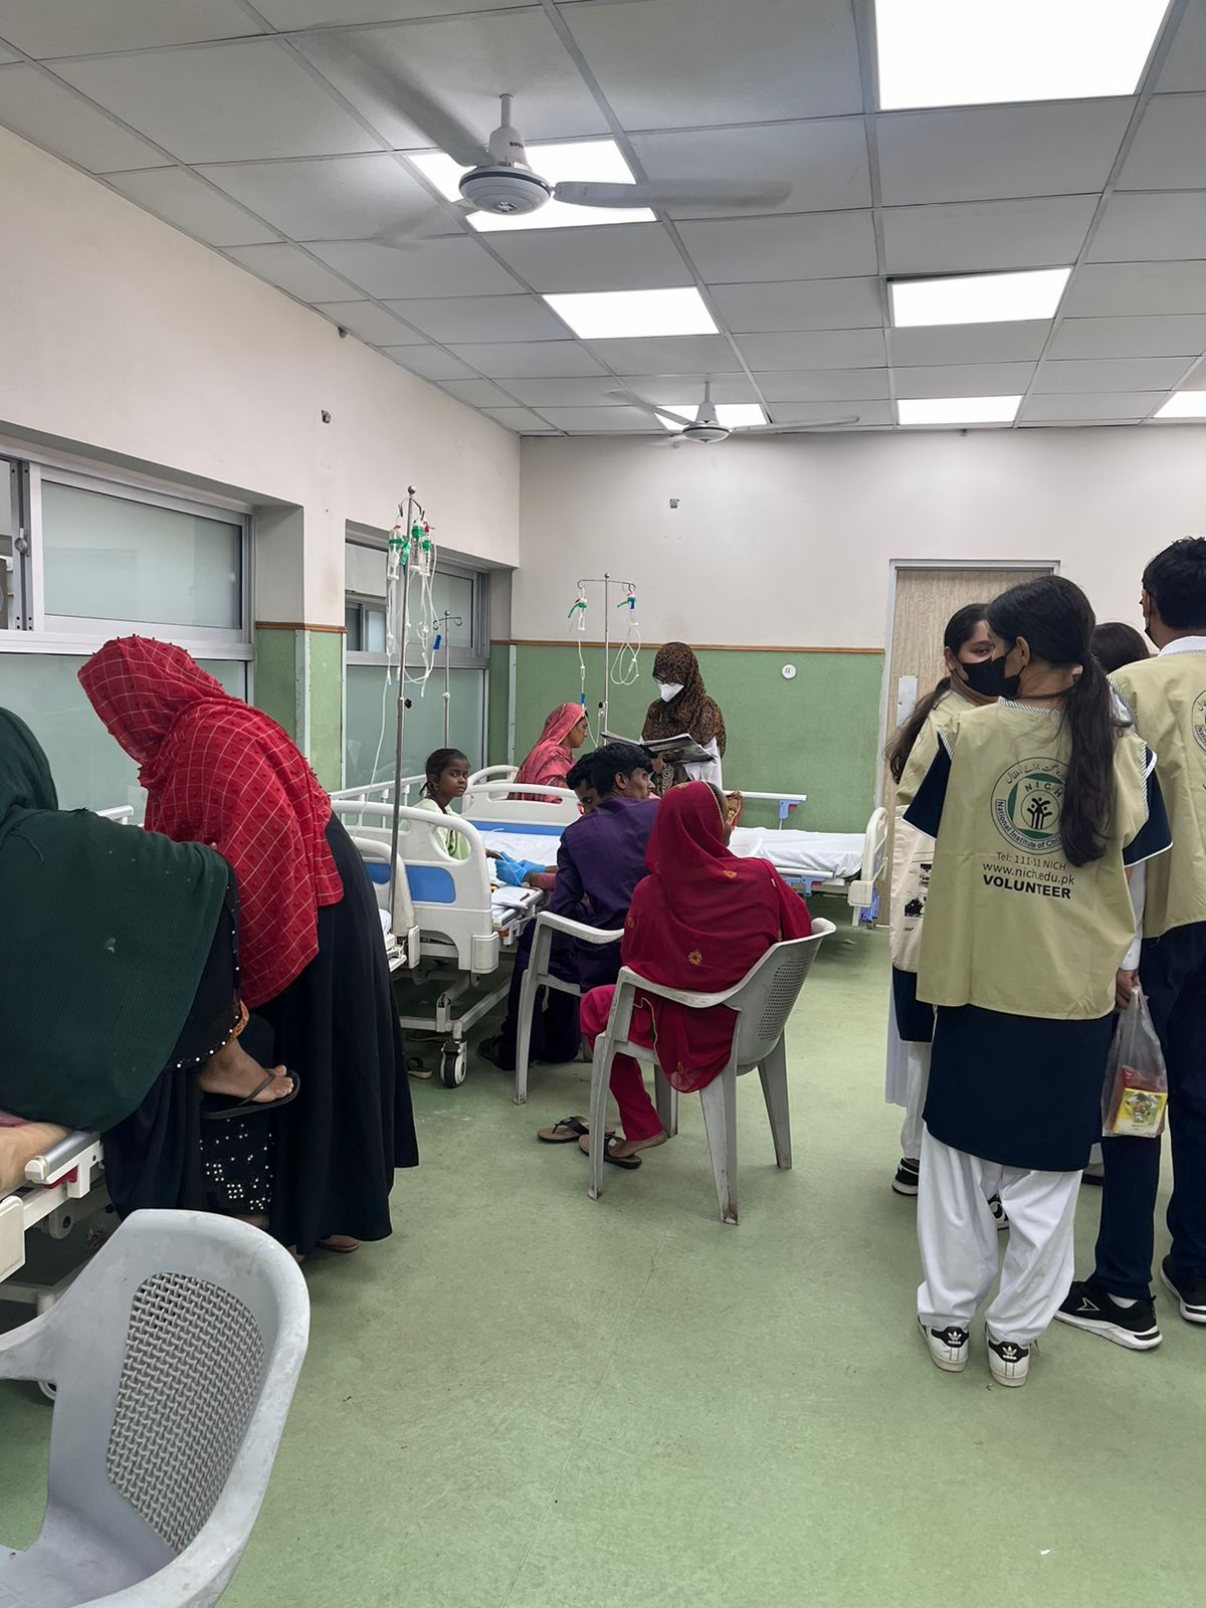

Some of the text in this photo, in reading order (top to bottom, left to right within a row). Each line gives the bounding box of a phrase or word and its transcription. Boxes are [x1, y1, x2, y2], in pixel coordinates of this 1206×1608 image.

[1025, 781, 1064, 798] NICH
[997, 801, 1012, 833] National
[1010, 830, 1036, 848] Institute
[997, 851, 1012, 862] Tel:
[1043, 859, 1066, 871] NICH
[983, 863, 1075, 885] www.nich.edu.pk
[983, 874, 1071, 899] VOLUNTEER
